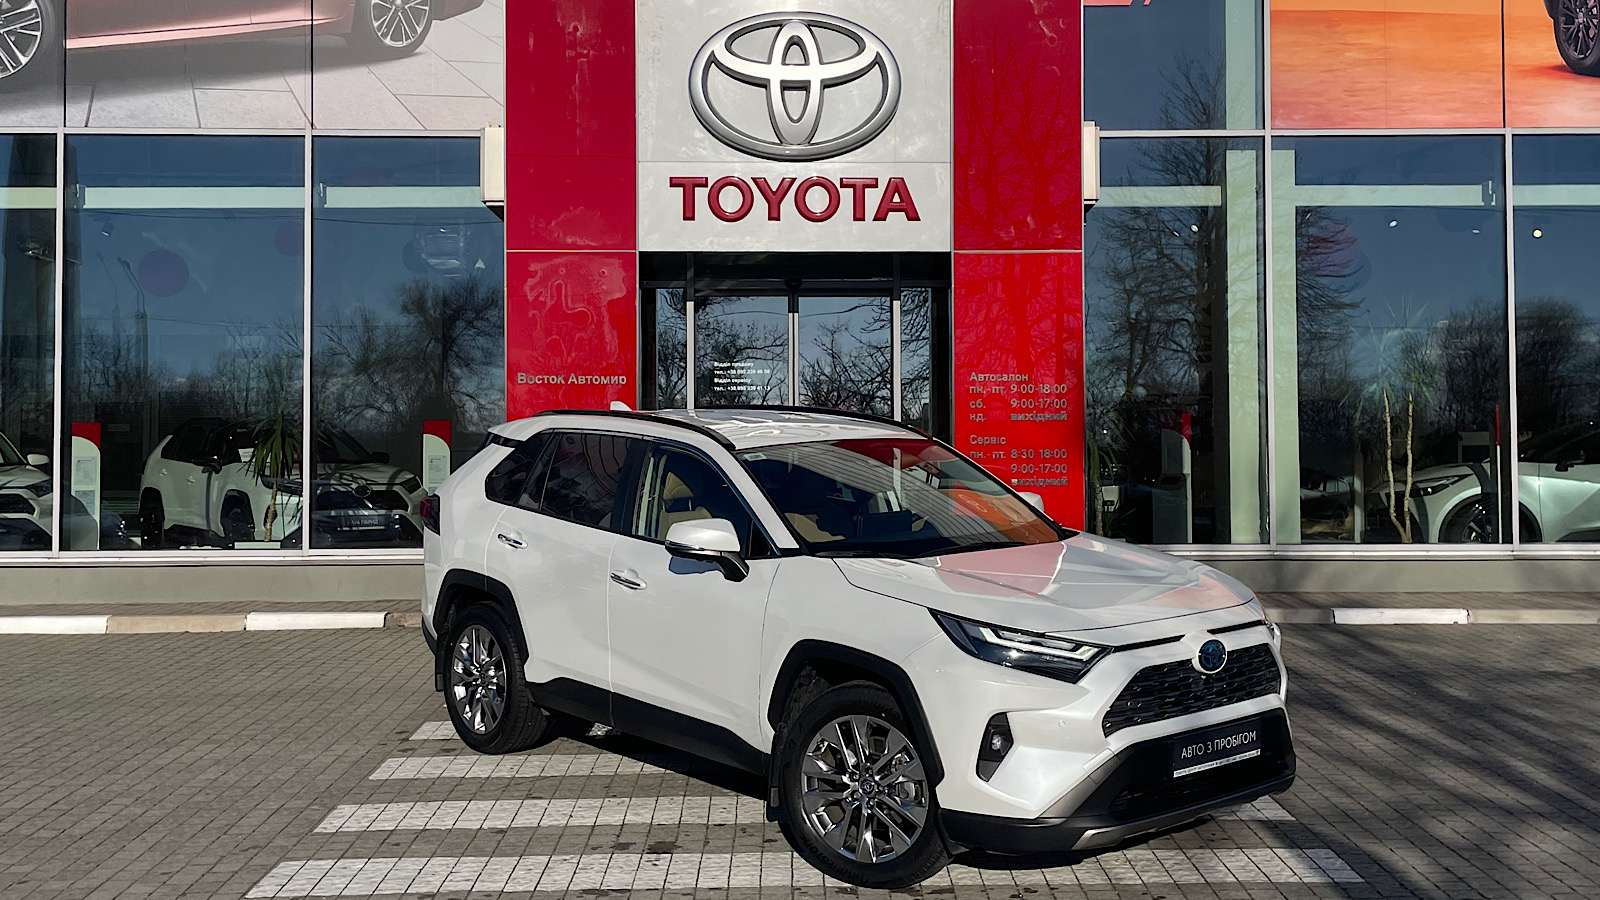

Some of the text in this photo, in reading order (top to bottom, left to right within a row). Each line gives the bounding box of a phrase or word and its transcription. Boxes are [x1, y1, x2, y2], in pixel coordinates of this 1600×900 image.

[669, 175, 921, 223] TOYOTA
[517, 373, 626, 386] Восток Автомир
[969, 371, 1029, 382] Автосалон
[969, 398, 1068, 409] сб. 9:00-17:00
[969, 411, 1068, 422] нд. вихідний
[969, 434, 1007, 446] Сервіс
[1010, 464, 1068, 473] 9:00-17:00
[1010, 476, 1069, 487] вихідний
[1180, 743, 1205, 759] АВТО
[1214, 731, 1257, 752] ПРОБІГОМ
